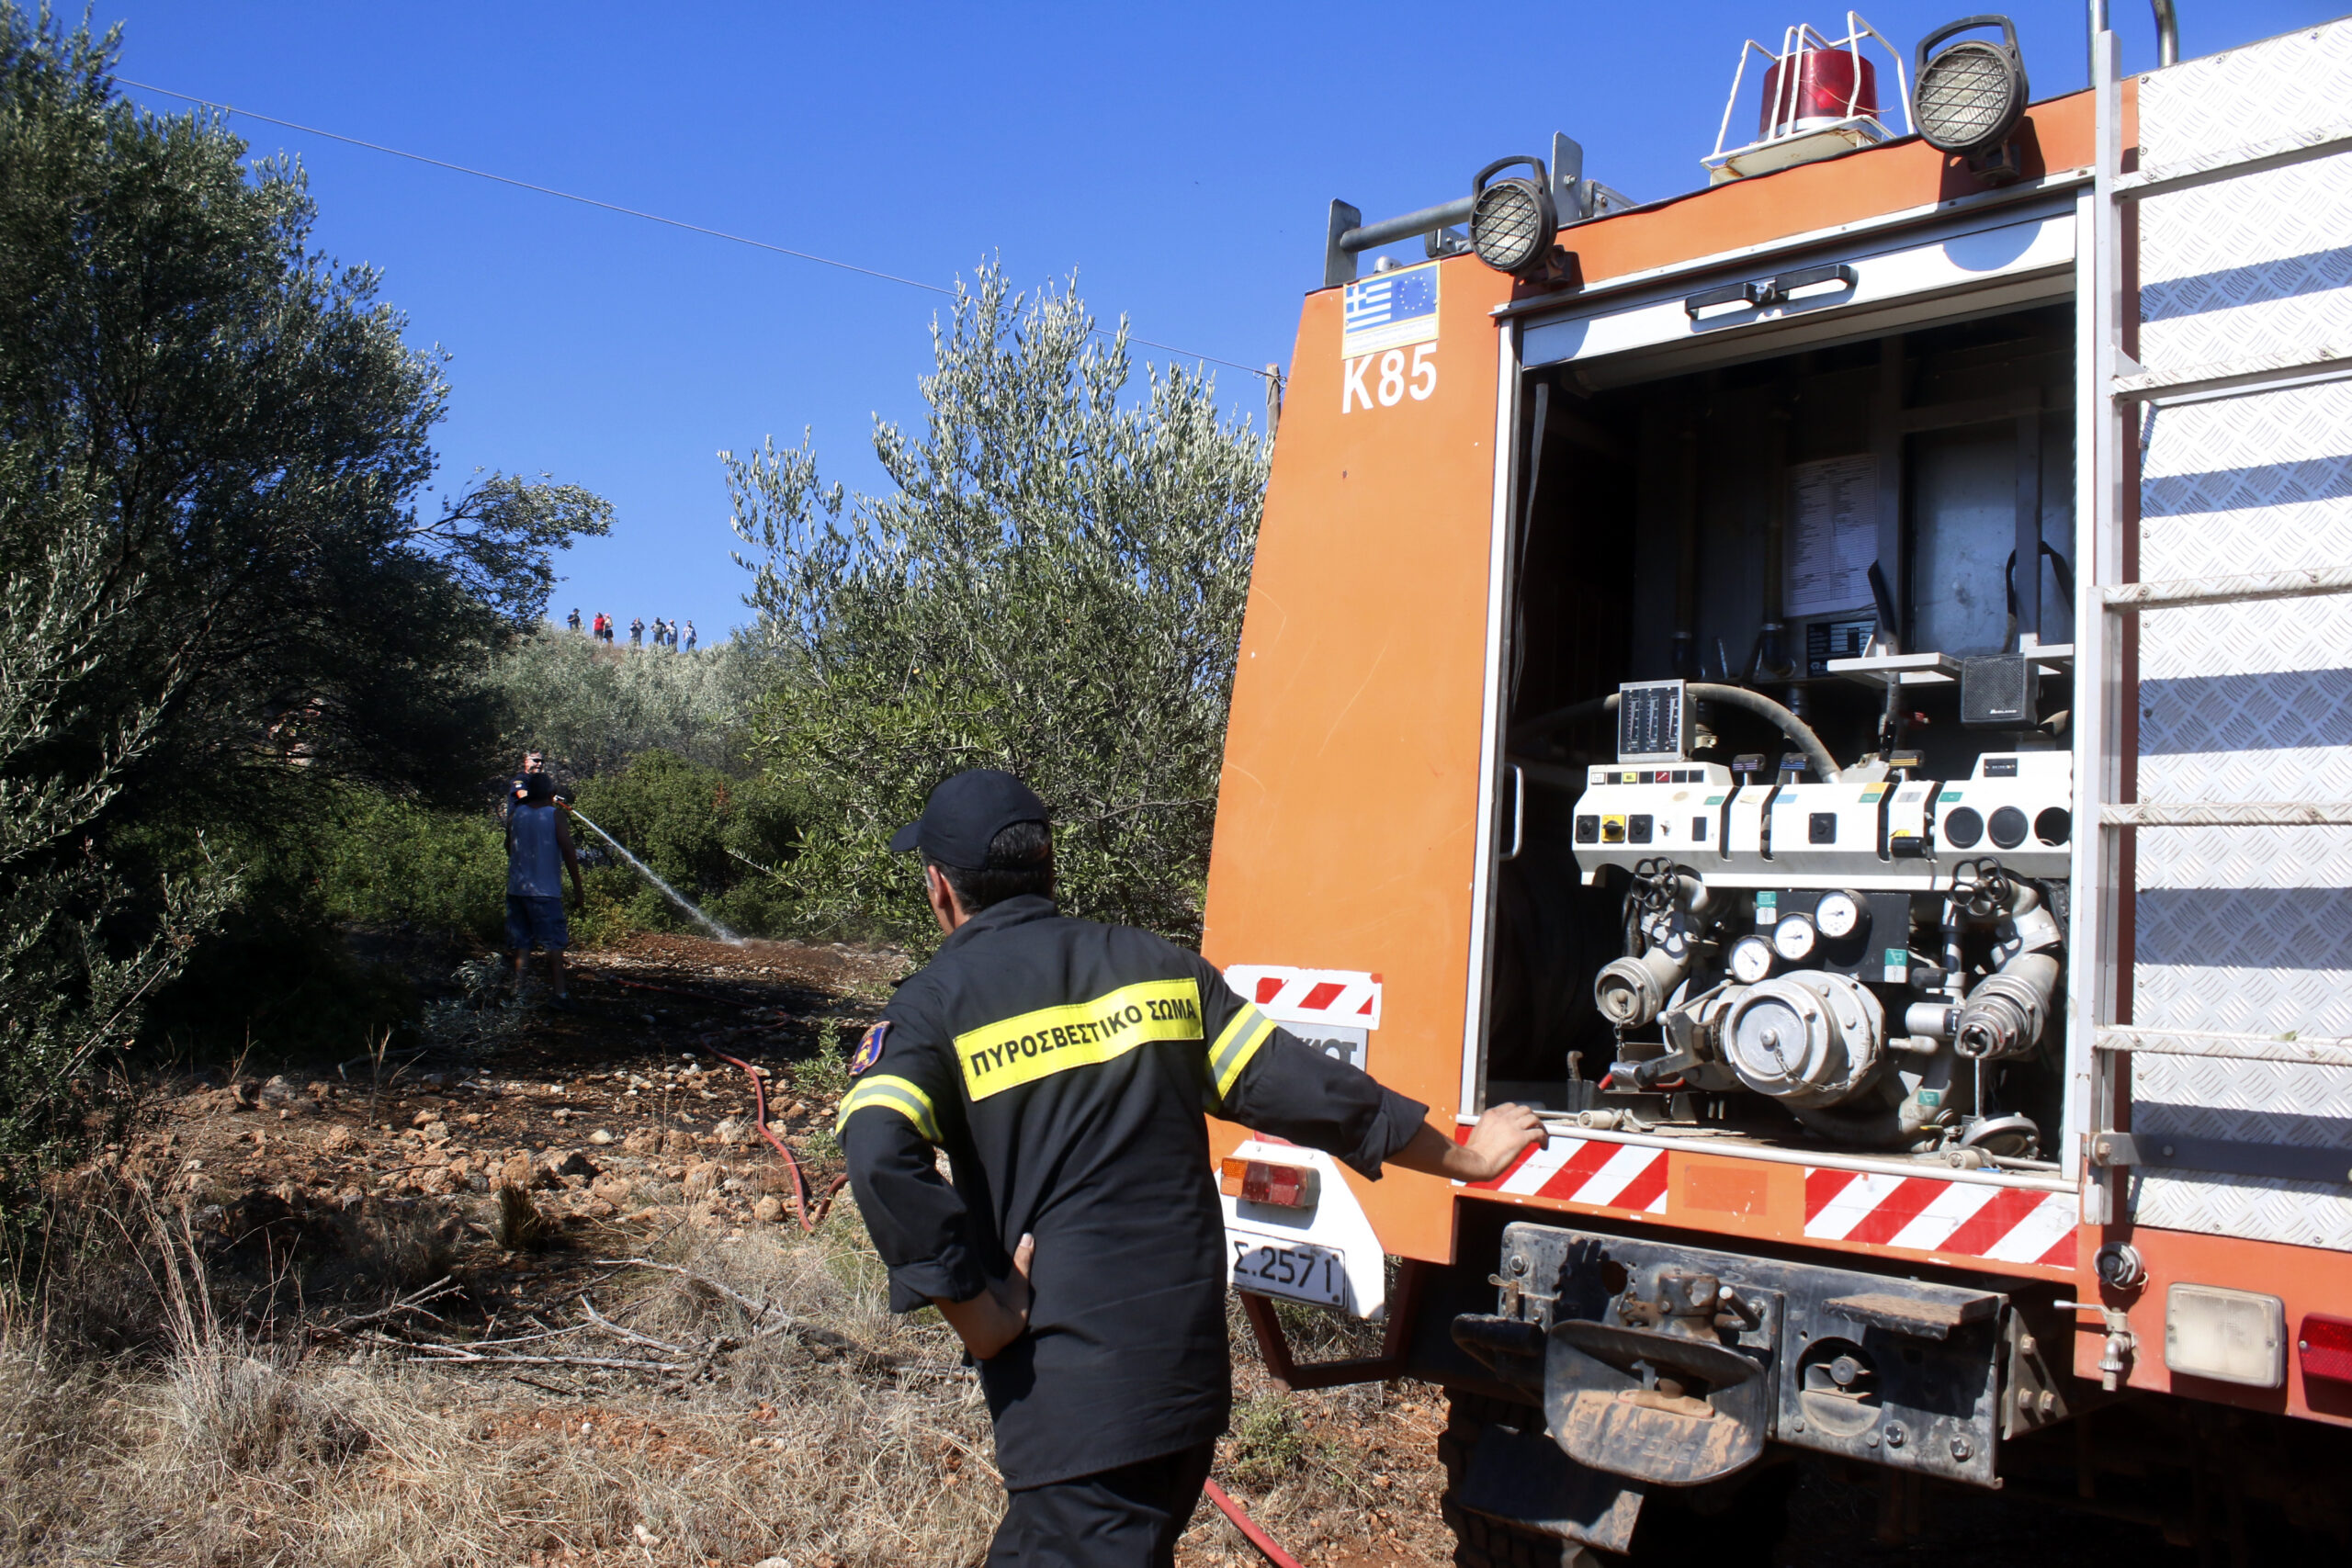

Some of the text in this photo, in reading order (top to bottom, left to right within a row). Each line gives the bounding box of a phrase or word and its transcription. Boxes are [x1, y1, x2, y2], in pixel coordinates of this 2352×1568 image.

[1342, 343, 1437, 413] K85
[971, 998, 1197, 1077] ΠΥΡΟΣΒΕΣΤΙΚΟ ΣΩΜΑ
